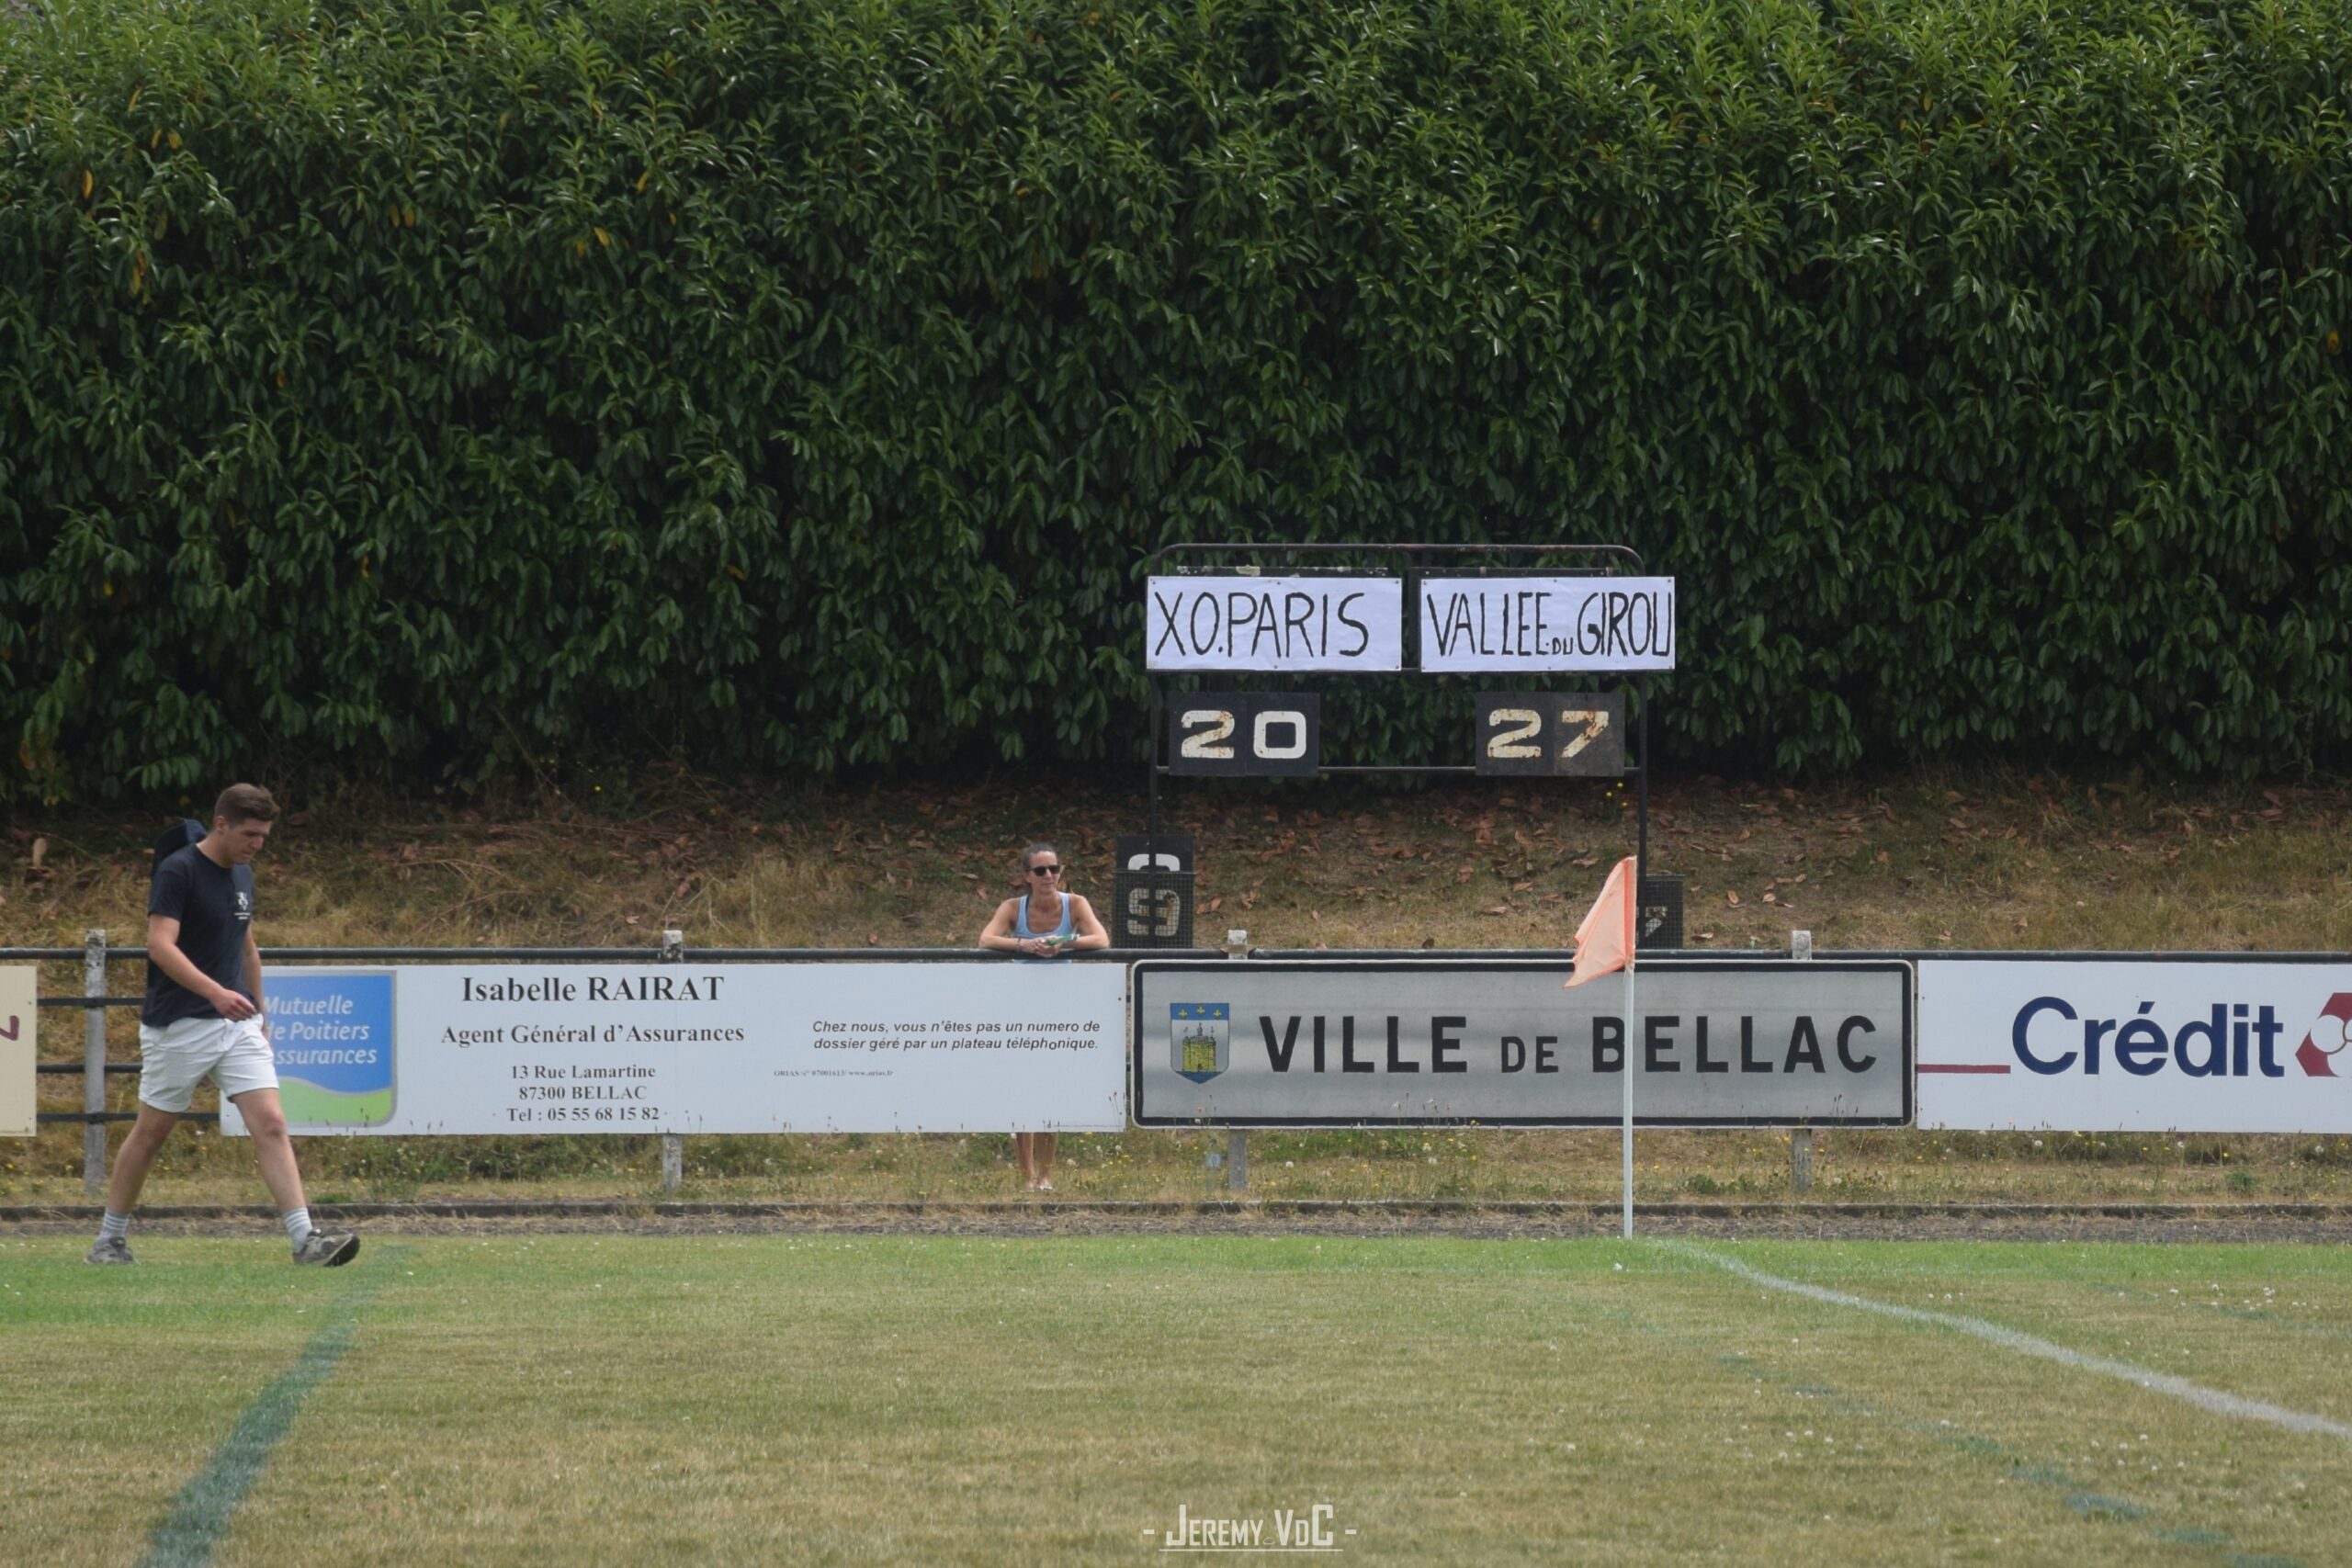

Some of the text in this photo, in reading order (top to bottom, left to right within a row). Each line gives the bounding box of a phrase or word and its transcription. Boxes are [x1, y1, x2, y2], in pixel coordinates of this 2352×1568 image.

[1155, 592, 1369, 658] XO.PARIS
[1577, 592, 1671, 657] GIROU
[1182, 711, 1306, 758] 20
[1488, 709, 1608, 758] 27
[464, 976, 724, 1001] Isabelle RAIRAT
[264, 995, 354, 1015] Mutuelle
[289, 1020, 369, 1041] Poitiers
[443, 1027, 503, 1047] Agent
[512, 1025, 594, 1043] Général
[813, 1021, 846, 1032] Chez
[852, 1023, 888, 1032] nous,
[977, 1023, 1001, 1034] pas
[1006, 1023, 1023, 1032] un
[1027, 1023, 1079, 1032] numero
[1083, 1021, 1100, 1032] de
[2012, 997, 2284, 1077] Crédit
[814, 1038, 865, 1048] dossier
[869, 1038, 899, 1052] géré
[904, 1041, 927, 1051] par
[952, 1038, 1001, 1051] plateau
[1007, 1037, 1097, 1051] téléphonique.
[1259, 1016, 1876, 1073] VILLE DE BELLAC
[276, 1048, 378, 1065] ssurances
[513, 1065, 655, 1078] 13 Rue Lamartine
[520, 1086, 646, 1100] 87300 BELLAC
[507, 1109, 531, 1122] Tel
[548, 1108, 566, 1121] 05
[572, 1108, 589, 1121] 55
[595, 1108, 612, 1120] 68
[620, 1107, 636, 1120] 15
[642, 1108, 659, 1120] 82
